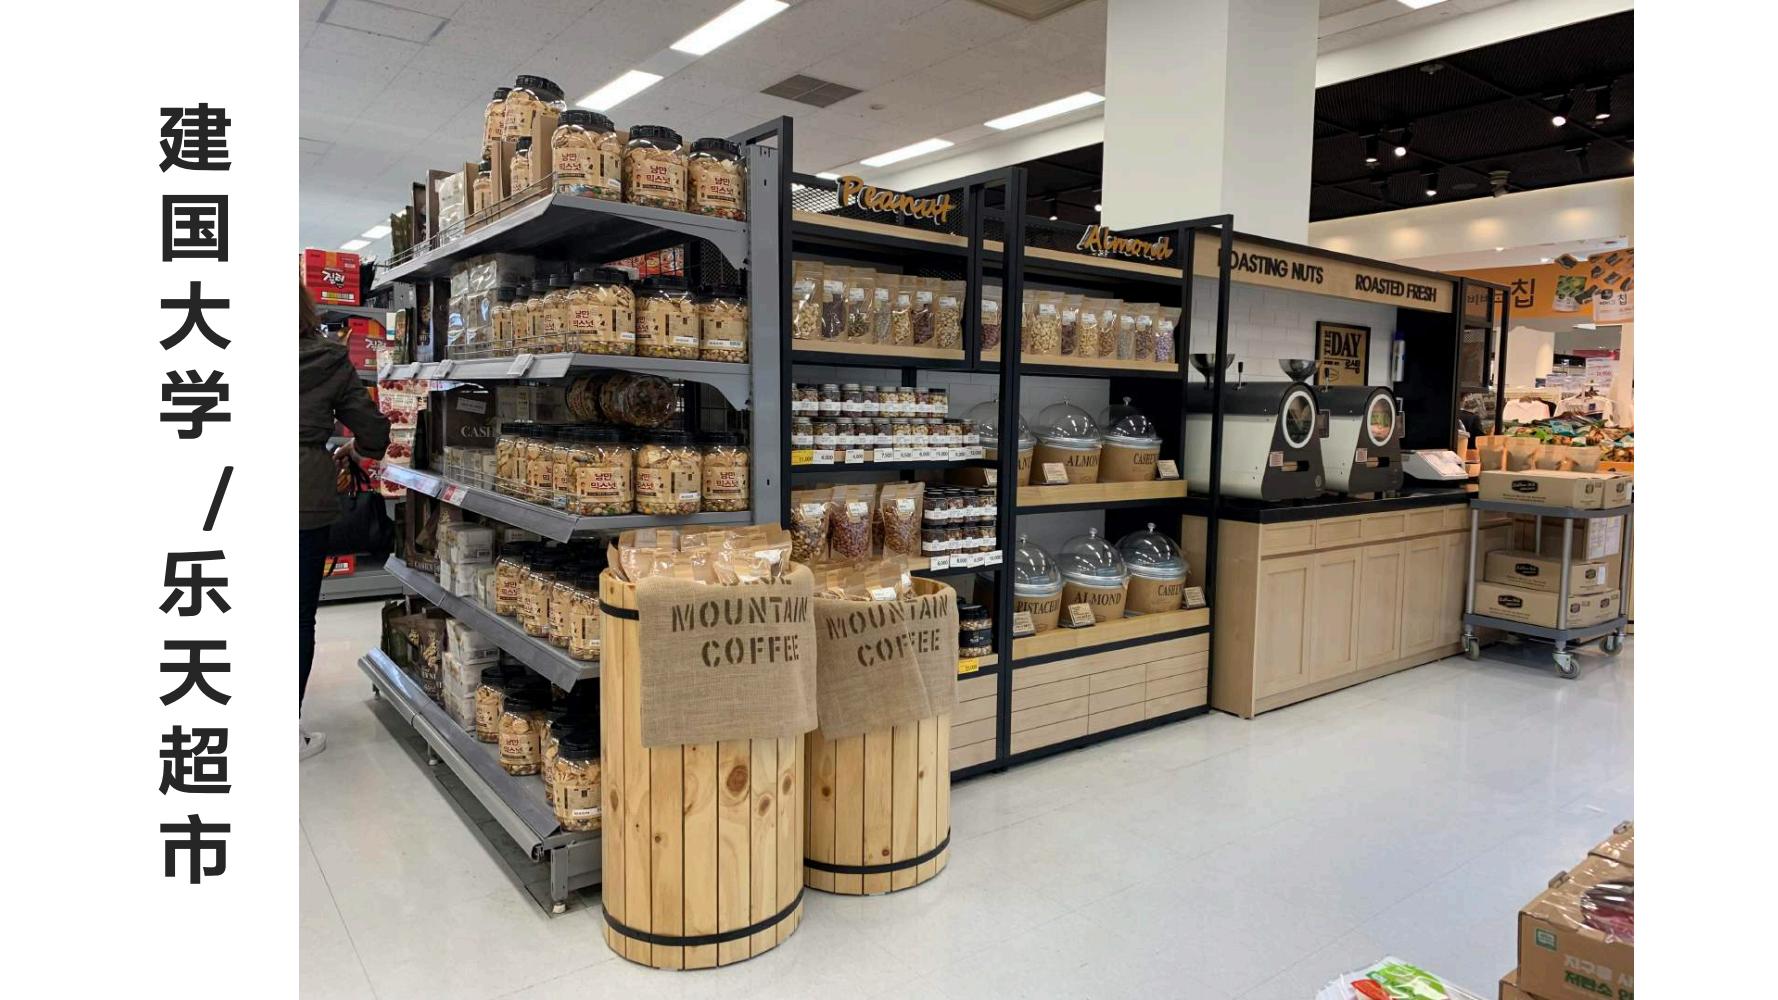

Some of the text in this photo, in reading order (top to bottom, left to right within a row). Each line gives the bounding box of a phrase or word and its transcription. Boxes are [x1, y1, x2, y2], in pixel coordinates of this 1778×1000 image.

[836, 175, 957, 225] Peanut
[1076, 223, 1173, 262] Almond
[1291, 261, 1324, 285] NUTS
[1355, 274, 1437, 302] ROASTED FRESH
[1331, 330, 1361, 358] DAY
[672, 596, 808, 633] MOUNTAIN
[1074, 591, 1122, 606] ALMOND
[825, 594, 948, 640] MOUNTAIN
[701, 634, 800, 668] COFFEE
[856, 628, 941, 667] COFFEE
